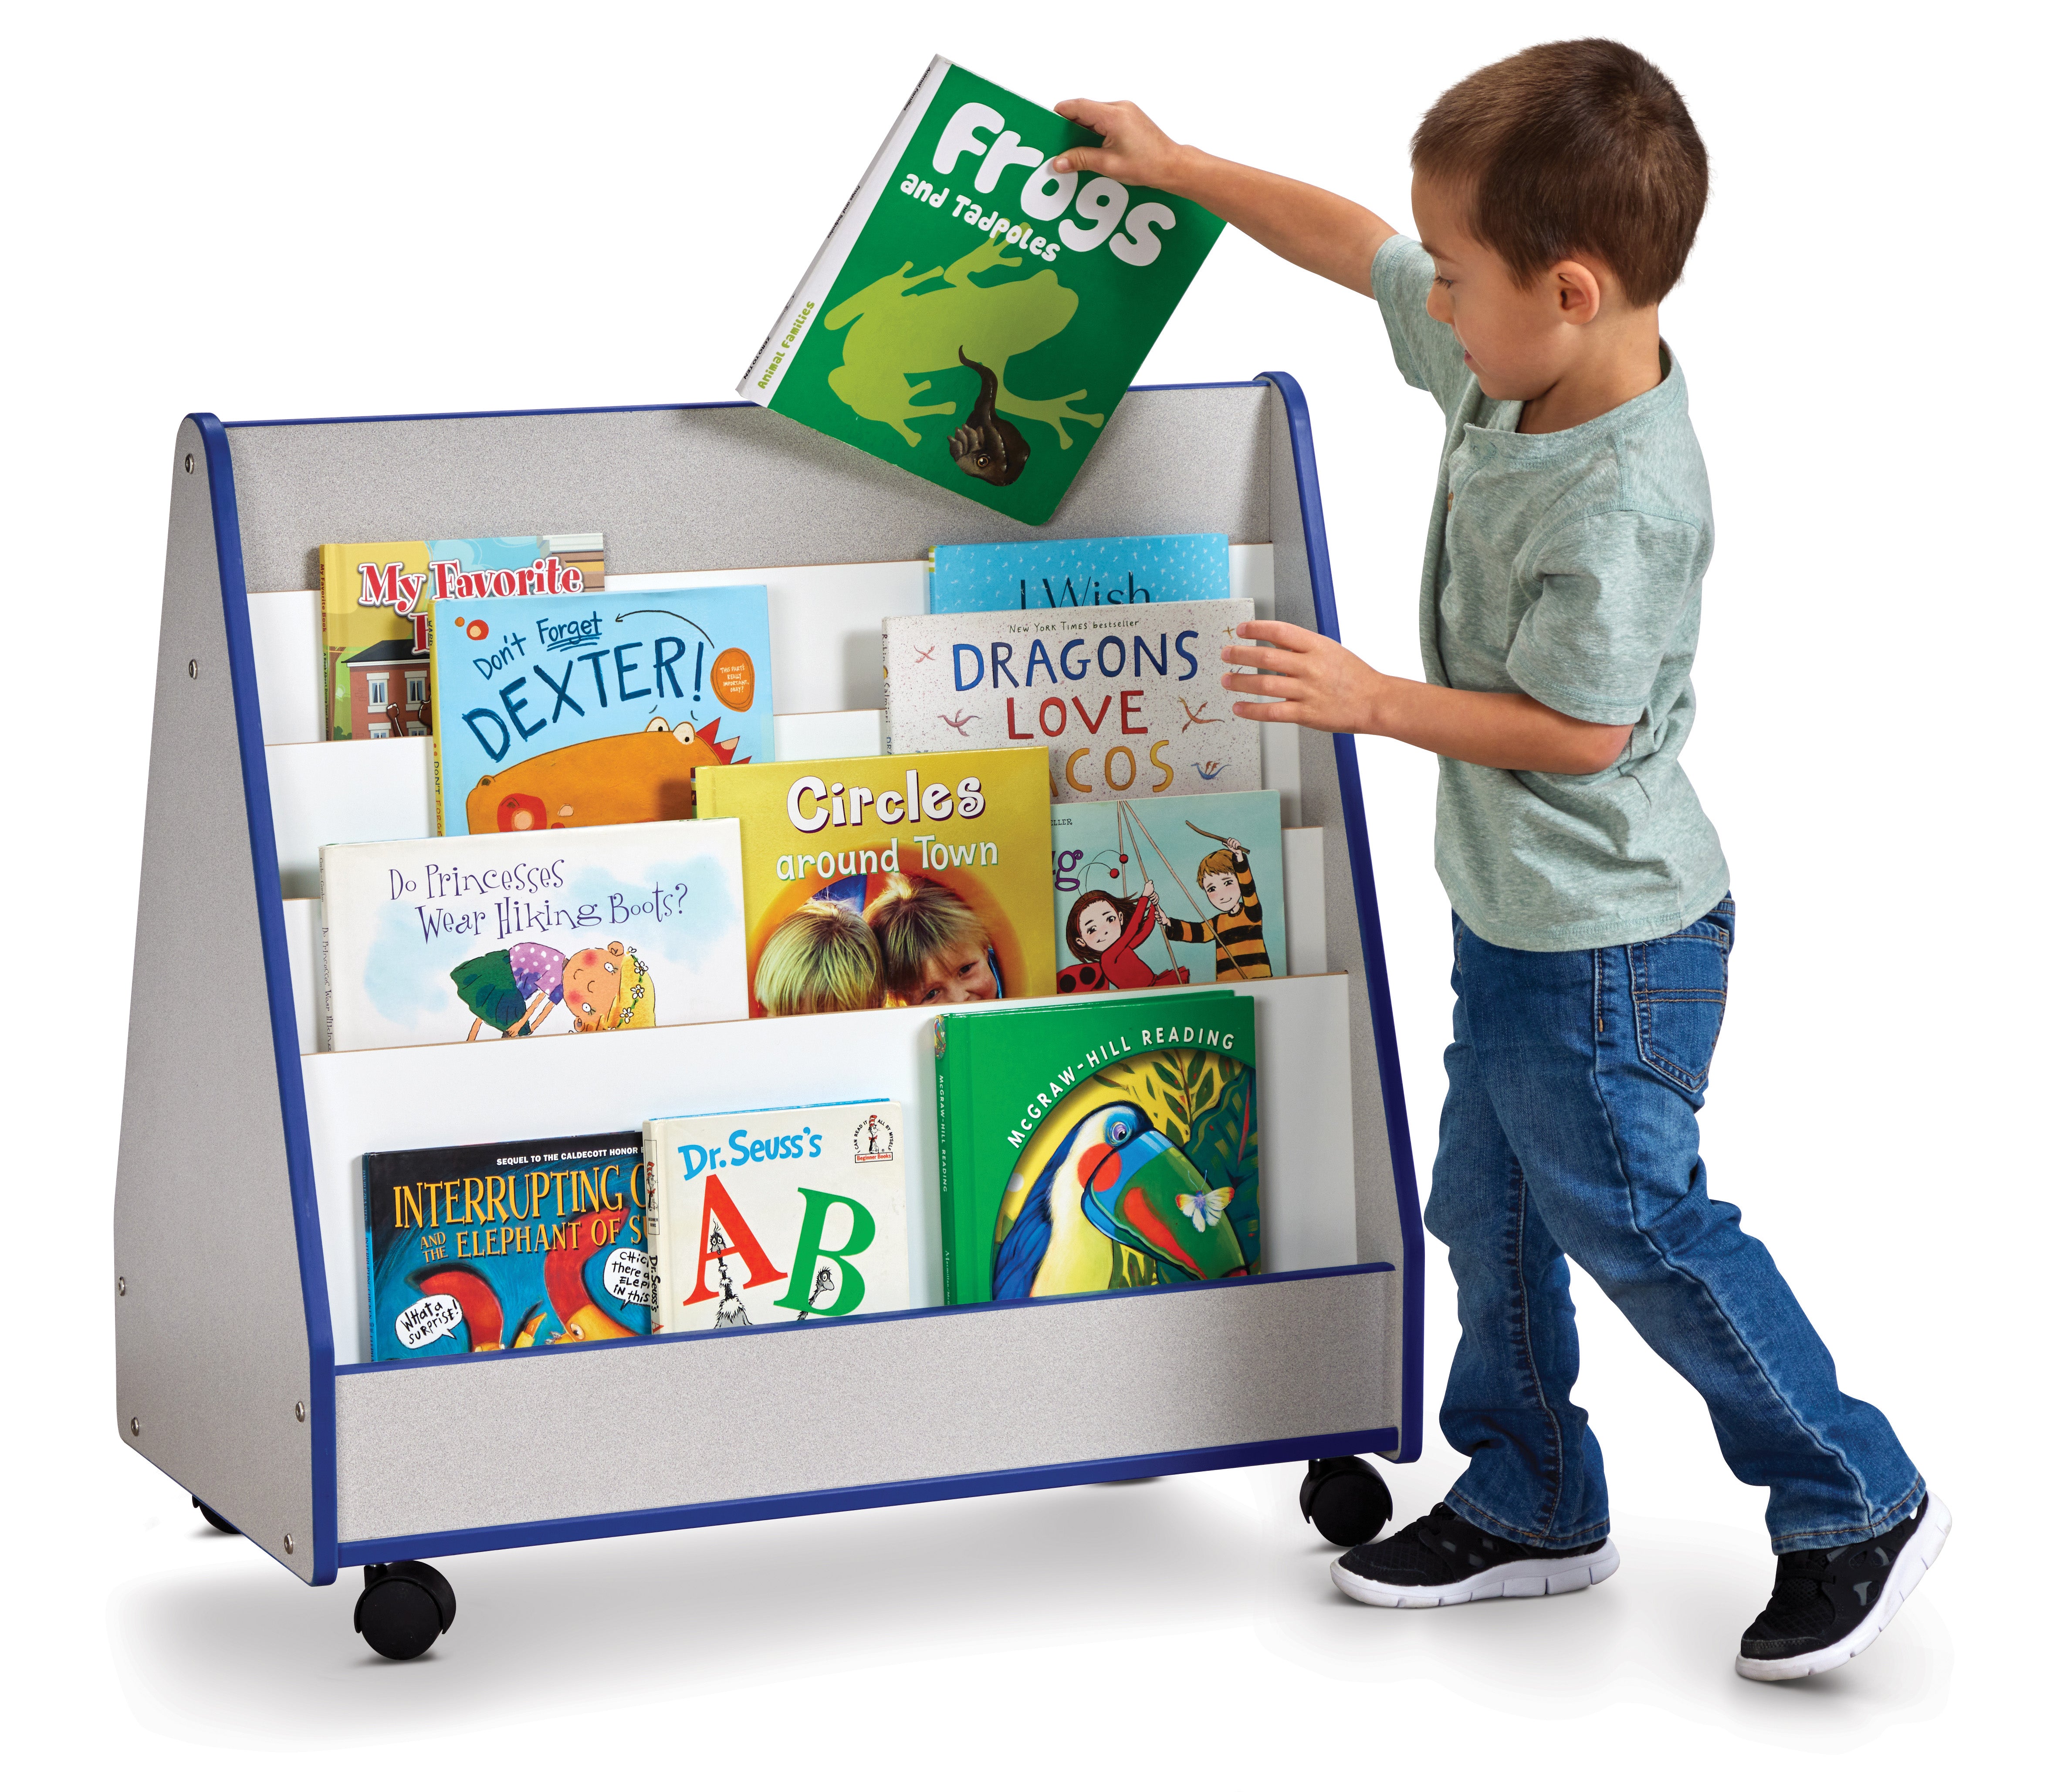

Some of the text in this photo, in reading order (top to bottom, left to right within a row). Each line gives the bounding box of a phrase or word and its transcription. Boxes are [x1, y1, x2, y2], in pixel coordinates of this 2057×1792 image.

[903, 67, 930, 111] Animal Families
[850, 185, 861, 201] Frogs
[933, 102, 1176, 266] Frogs
[827, 214, 843, 239] Tadpoles
[900, 173, 1060, 262] and Tadpoles
[744, 336, 771, 379] ZERO TO TEN
[320, 564, 324, 575] My
[359, 557, 583, 614] My Favorite
[1021, 571, 1150, 610] I Wish
[473, 633, 526, 680] Don't
[536, 611, 602, 645] Forget
[1010, 620, 1139, 633] NEW YORK TIMES bestseller
[953, 630, 1199, 691] DRAGONS
[462, 636, 704, 763] DEXTER!
[1007, 690, 1148, 740] LOVE
[787, 769, 986, 833] Circles
[777, 834, 998, 881] around Town
[389, 859, 565, 900] Do Princesses
[415, 881, 688, 945] Wear Hiking Boots?
[1141, 1026, 1235, 1050] READING
[854, 1125, 863, 1137] READ
[497, 1157, 528, 1165] SEQUEL
[561, 1149, 607, 1160] CALDECOTT
[610, 1147, 638, 1155] HONOR
[677, 1127, 822, 1181] Dr. Seuss's
[393, 1165, 623, 1229] INTERRUPTING
[421, 1232, 446, 1250] AND
[423, 1247, 448, 1263] THE
[457, 1221, 581, 1258] ELEPHANT
[591, 1217, 620, 1246] OF
[649, 1255, 658, 1274] Dr.
